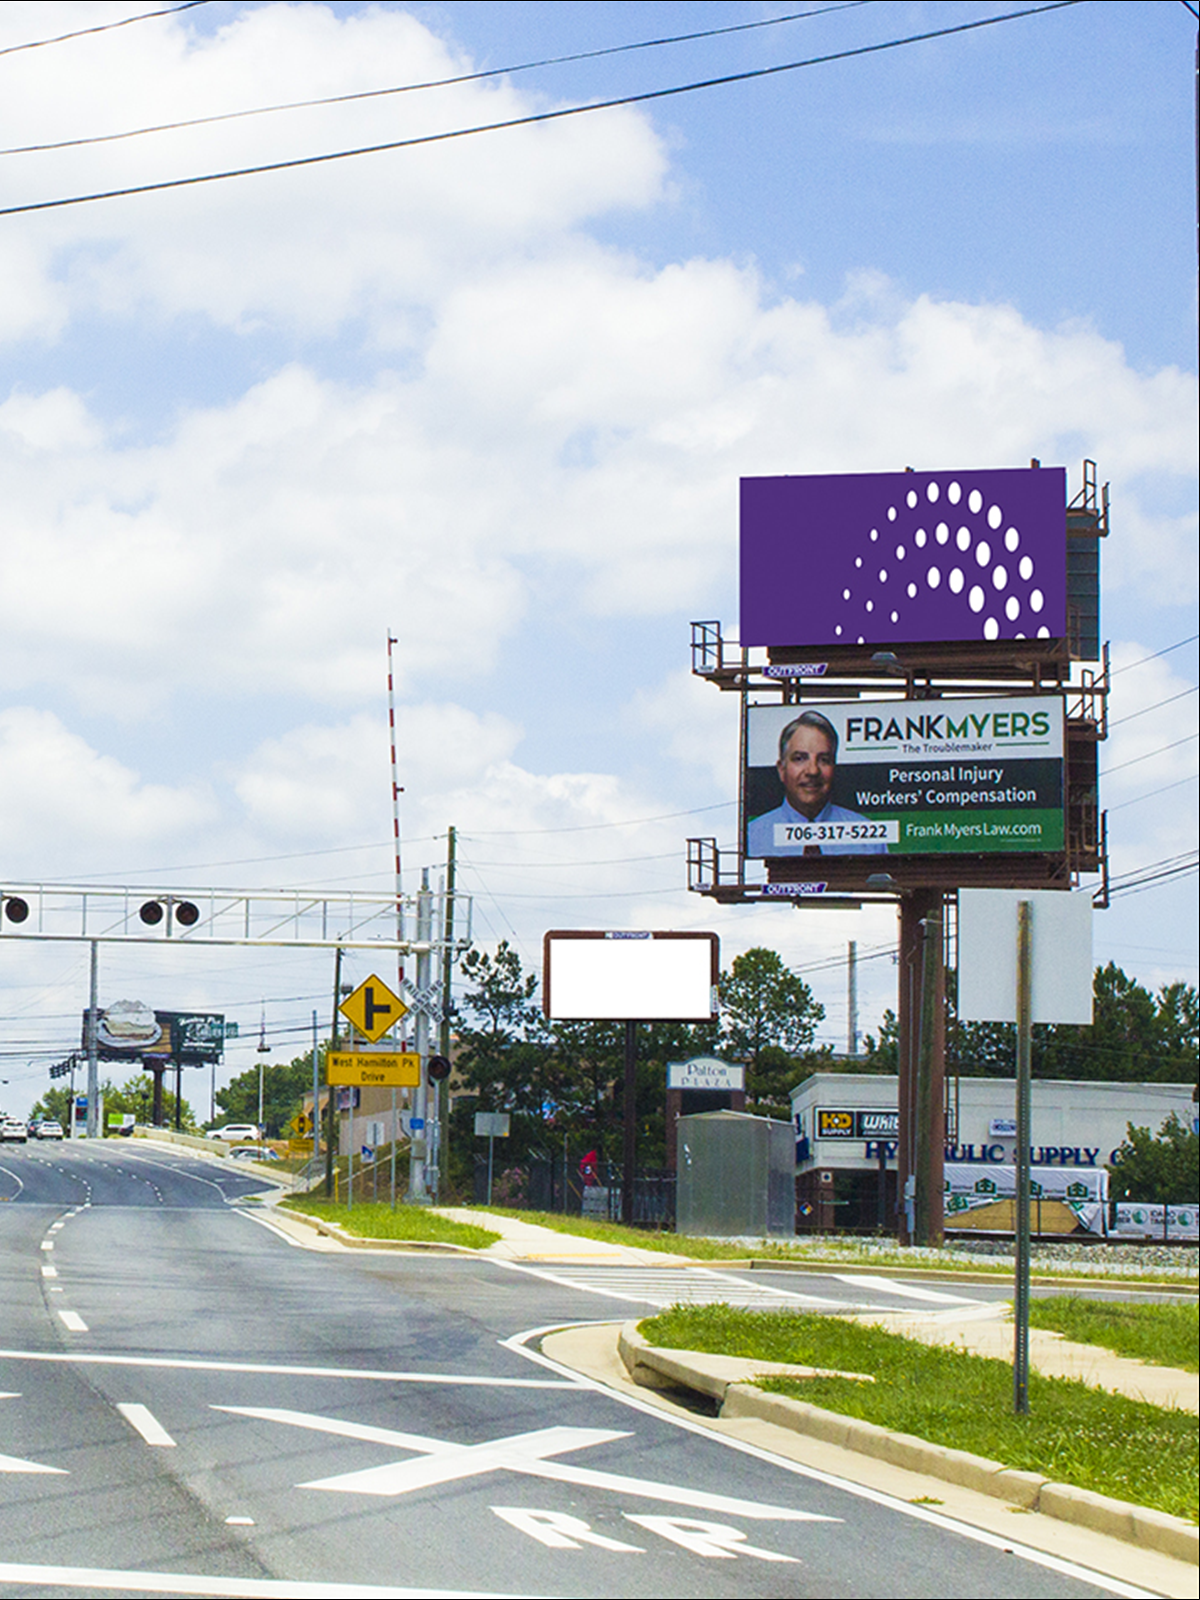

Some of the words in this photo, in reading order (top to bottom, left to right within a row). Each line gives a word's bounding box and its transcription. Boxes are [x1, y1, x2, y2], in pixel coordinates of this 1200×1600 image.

[767, 664, 819, 676] OUTFRONT
[902, 743, 921, 754] The
[922, 742, 993, 753] Troublemaker
[889, 766, 954, 783] Personal
[958, 765, 1004, 784] Injury
[925, 787, 1037, 806] Compensation
[785, 825, 887, 840] 706-317-5222
[767, 884, 818, 895] OUTFRONT
[332, 1057, 353, 1067] West
[357, 1057, 398, 1067] Hamilton
[402, 1057, 415, 1067] Pk
[361, 1071, 385, 1082] Drive
[863, 1114, 899, 1129] Whit
[1013, 1147, 1099, 1166] UPPLY
